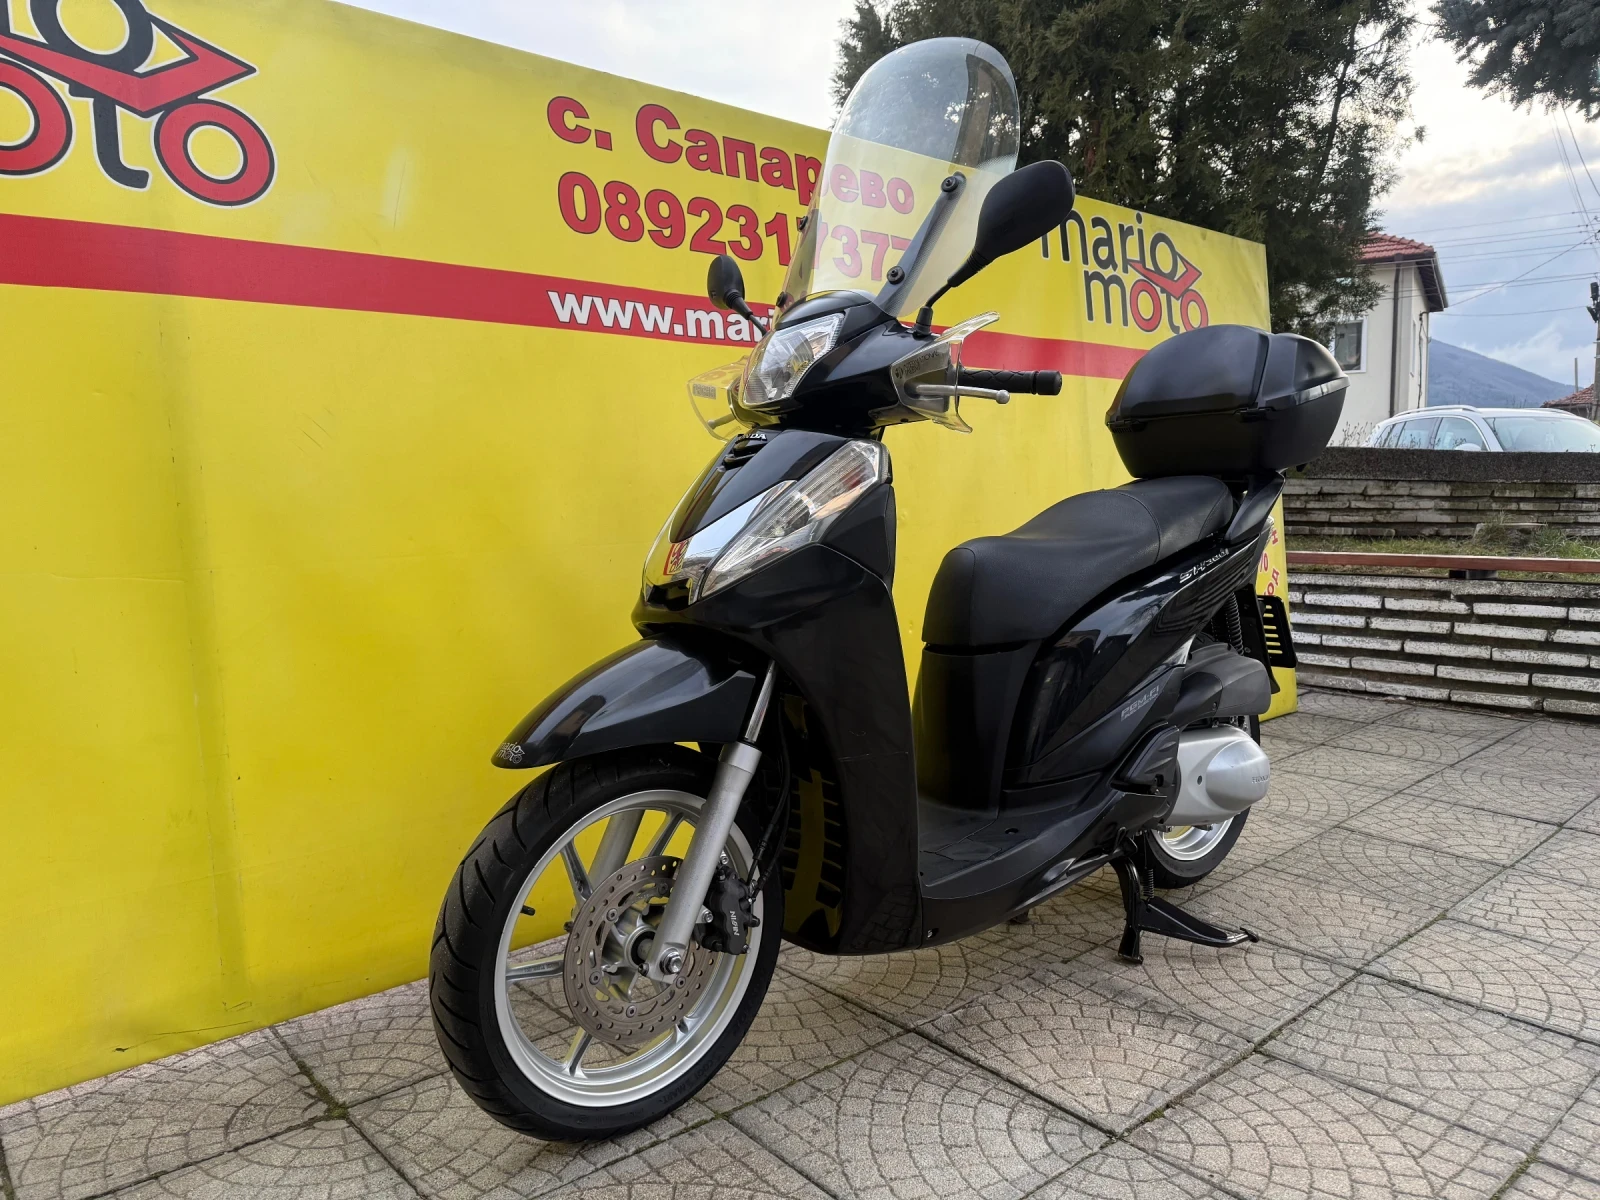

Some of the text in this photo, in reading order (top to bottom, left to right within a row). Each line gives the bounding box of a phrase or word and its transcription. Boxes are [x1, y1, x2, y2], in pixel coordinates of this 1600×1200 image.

[547, 96, 915, 215] с. Сапарево
[1083, 269, 1209, 334] moto
